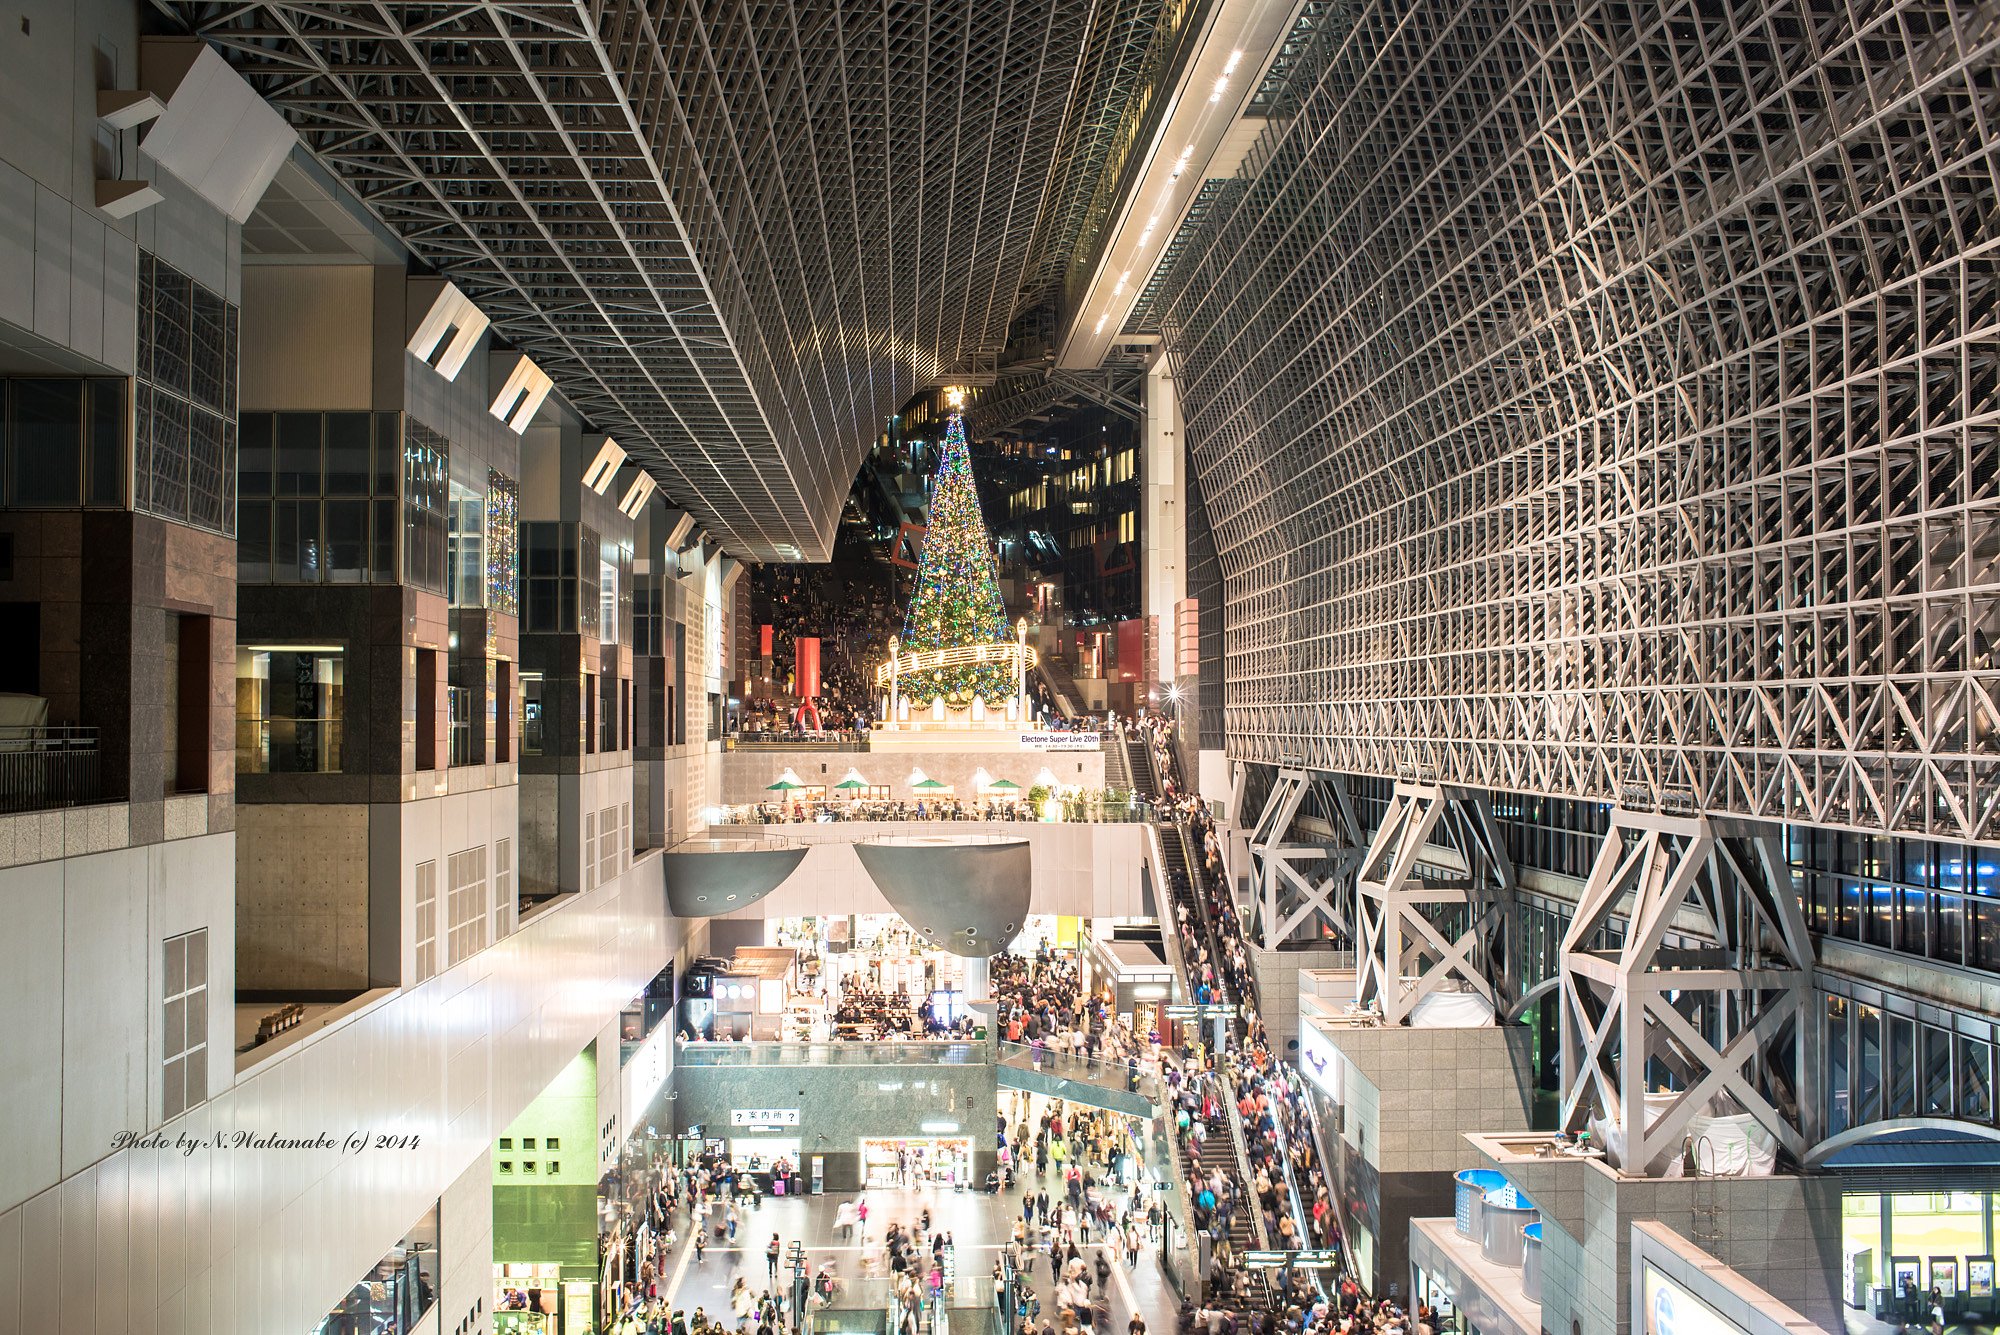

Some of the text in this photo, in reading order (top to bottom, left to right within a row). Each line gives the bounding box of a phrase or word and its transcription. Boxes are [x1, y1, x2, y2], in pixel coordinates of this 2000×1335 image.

[1021, 735, 1099, 744] Electone Super Live 20th
